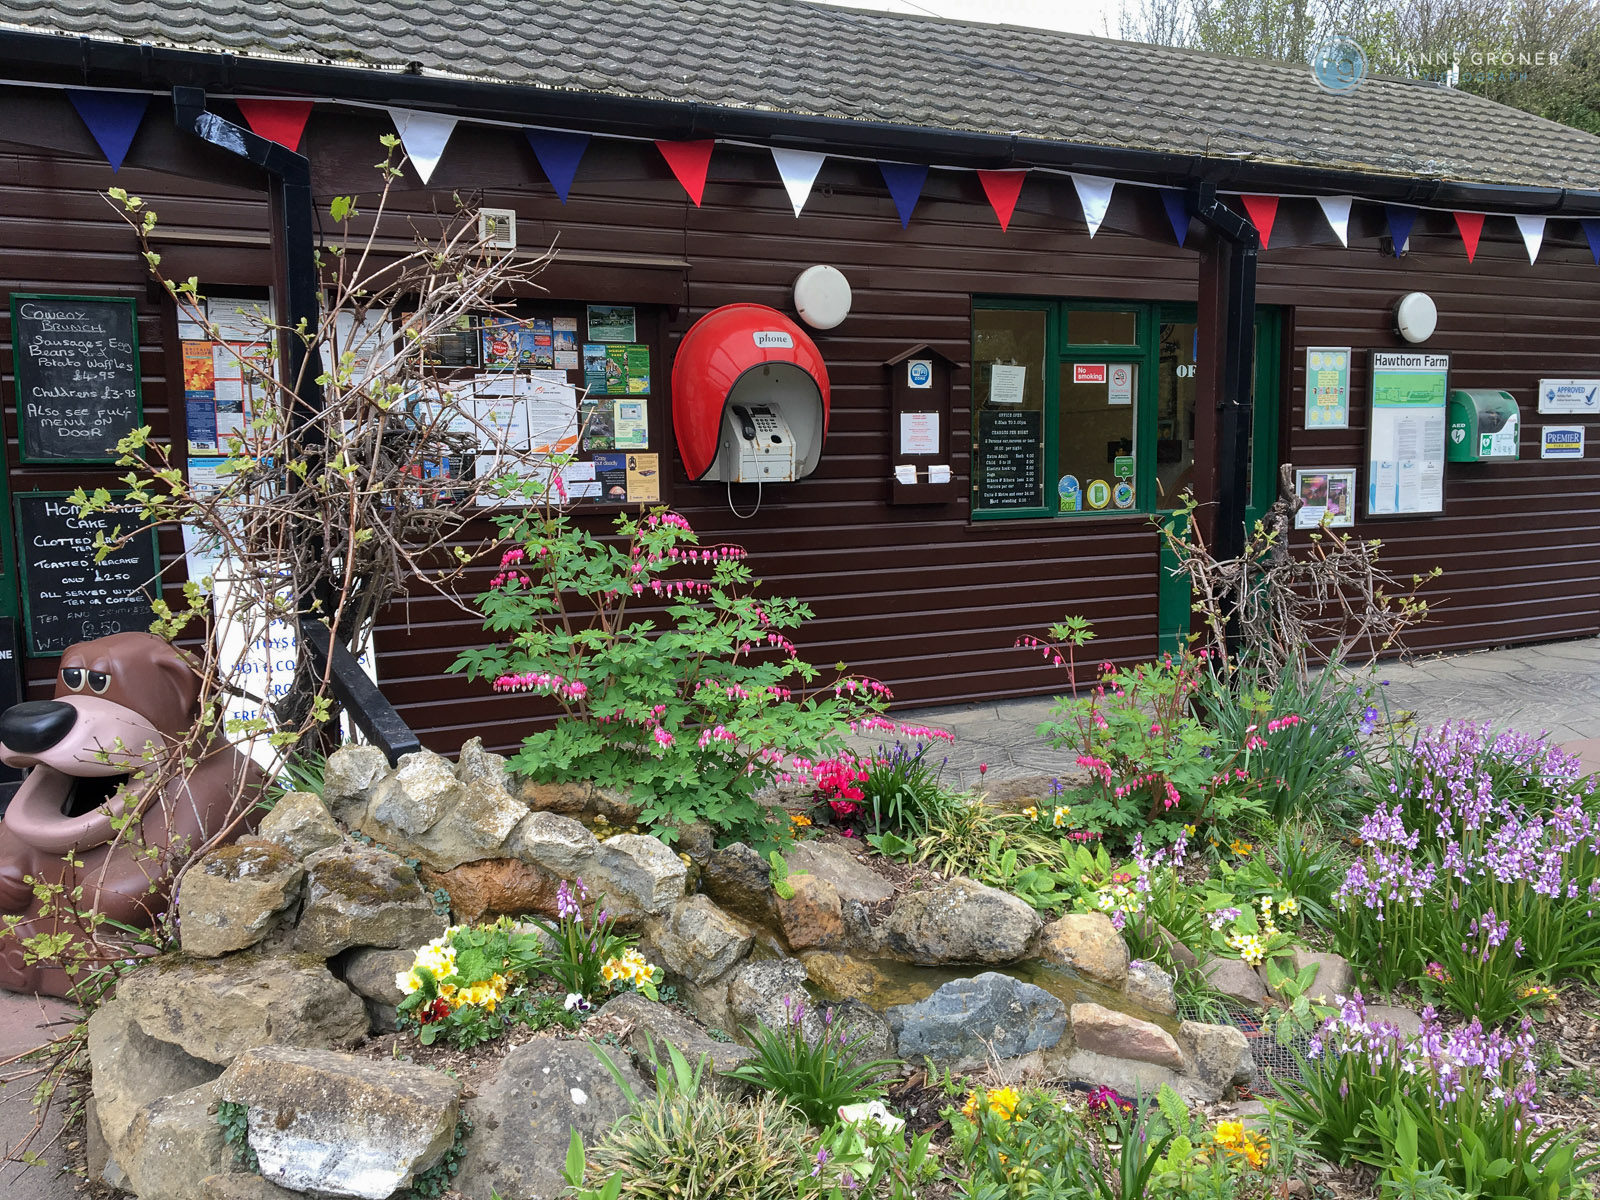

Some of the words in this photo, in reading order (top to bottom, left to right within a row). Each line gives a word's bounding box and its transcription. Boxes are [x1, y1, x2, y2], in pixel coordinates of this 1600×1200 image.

[758, 332, 788, 344] phone
[34, 335, 103, 353] Sausages
[108, 337, 133, 354] Egg
[29, 345, 76, 357] Beans
[38, 357, 82, 367] Potato
[86, 358, 134, 372] Waffles
[1374, 355, 1421, 367] Hawthorn
[1424, 355, 1448, 367] Farm
[1078, 373, 1102, 381] smoking
[41, 418, 85, 427] MENU
[58, 428, 103, 437] DOOR
[1547, 433, 1580, 443] PREMIER
[45, 502, 94, 516] HOM
[1061, 502, 1075, 511] 2017
[66, 518, 108, 529] CAKE
[33, 535, 92, 547] CLOTTED
[33, 560, 89, 569] TOASTED
[105, 596, 145, 605] COFFEE
[36, 615, 59, 624] TEA
